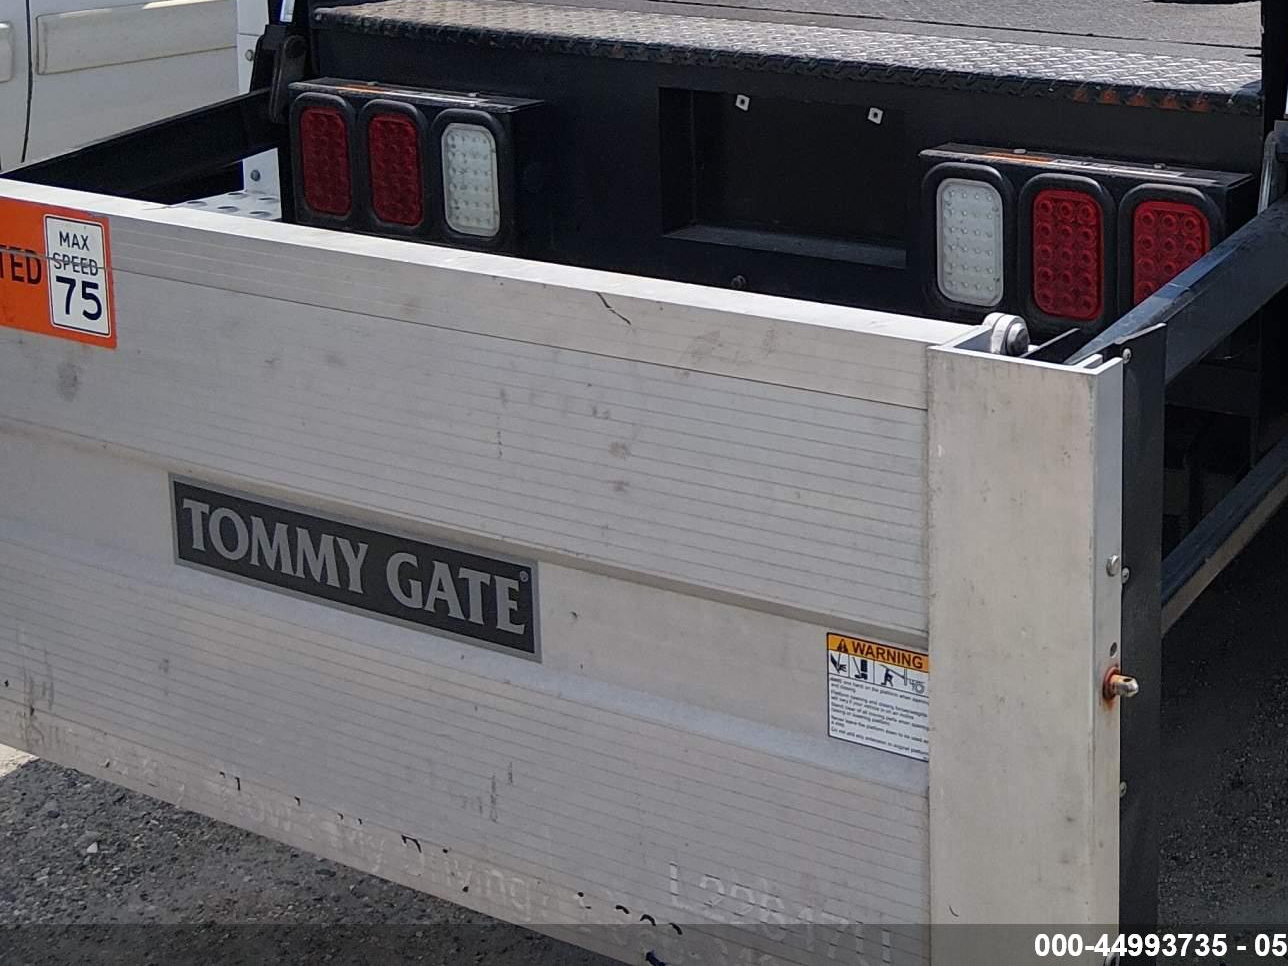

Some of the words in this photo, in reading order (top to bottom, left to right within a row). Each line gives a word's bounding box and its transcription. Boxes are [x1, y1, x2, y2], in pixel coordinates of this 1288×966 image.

[59, 230, 90, 251] MAX
[53, 252, 98, 276] SPEED
[56, 275, 103, 321] 75
[182, 497, 368, 594] TOMMY
[851, 641, 923, 669] WARNING
